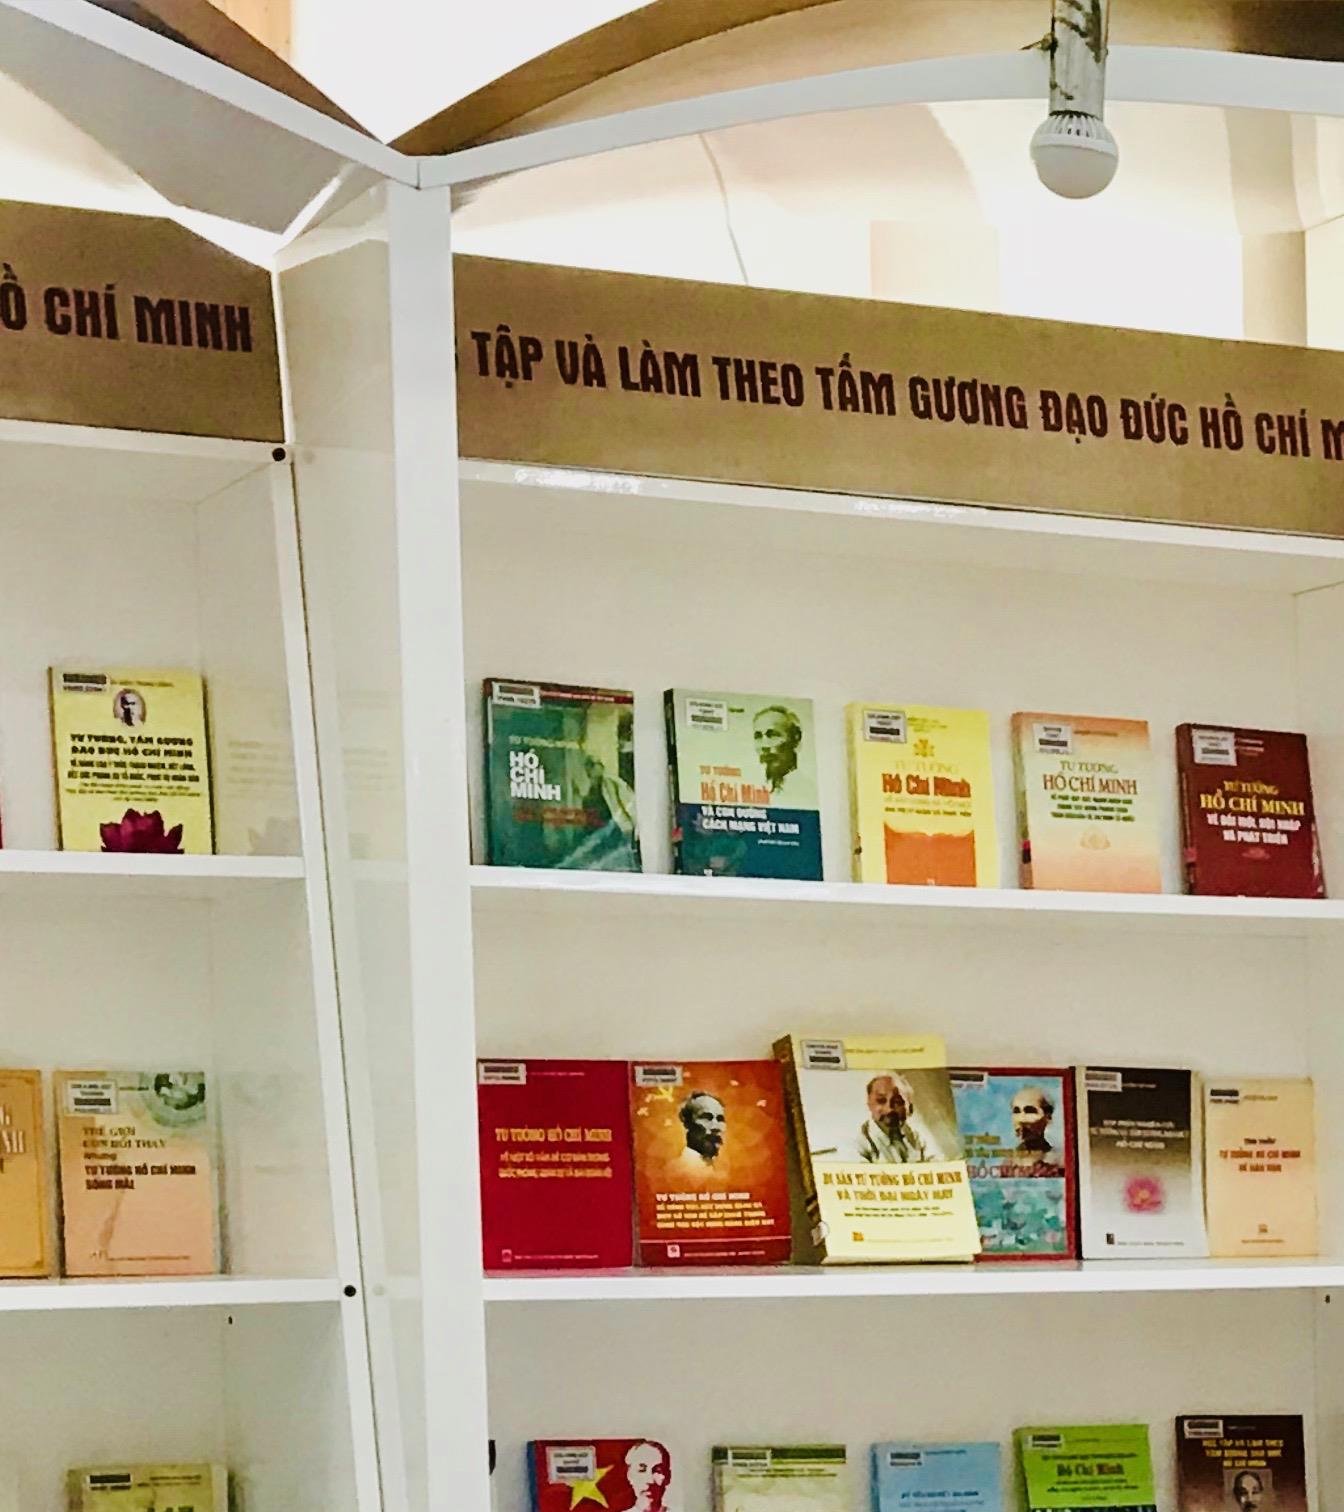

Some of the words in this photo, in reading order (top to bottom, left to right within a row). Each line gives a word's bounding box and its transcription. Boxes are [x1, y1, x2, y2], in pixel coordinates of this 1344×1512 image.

[0, 262, 27, 331] Ồ
[44, 284, 120, 340] CHÍ
[134, 295, 253, 352] MINH
[471, 324, 543, 388] TẬP
[555, 334, 606, 388] VÀ
[619, 339, 701, 397] LÀM
[712, 356, 804, 406] THEO
[815, 352, 896, 416] TẤM
[909, 375, 1028, 429] GƯƠNG
[1040, 389, 1108, 444] ĐẠO
[1120, 392, 1189, 445] ĐỨC
[1200, 393, 1243, 450] HỒ
[1255, 409, 1310, 457] CHÍ
[510, 783, 561, 801] MINH
